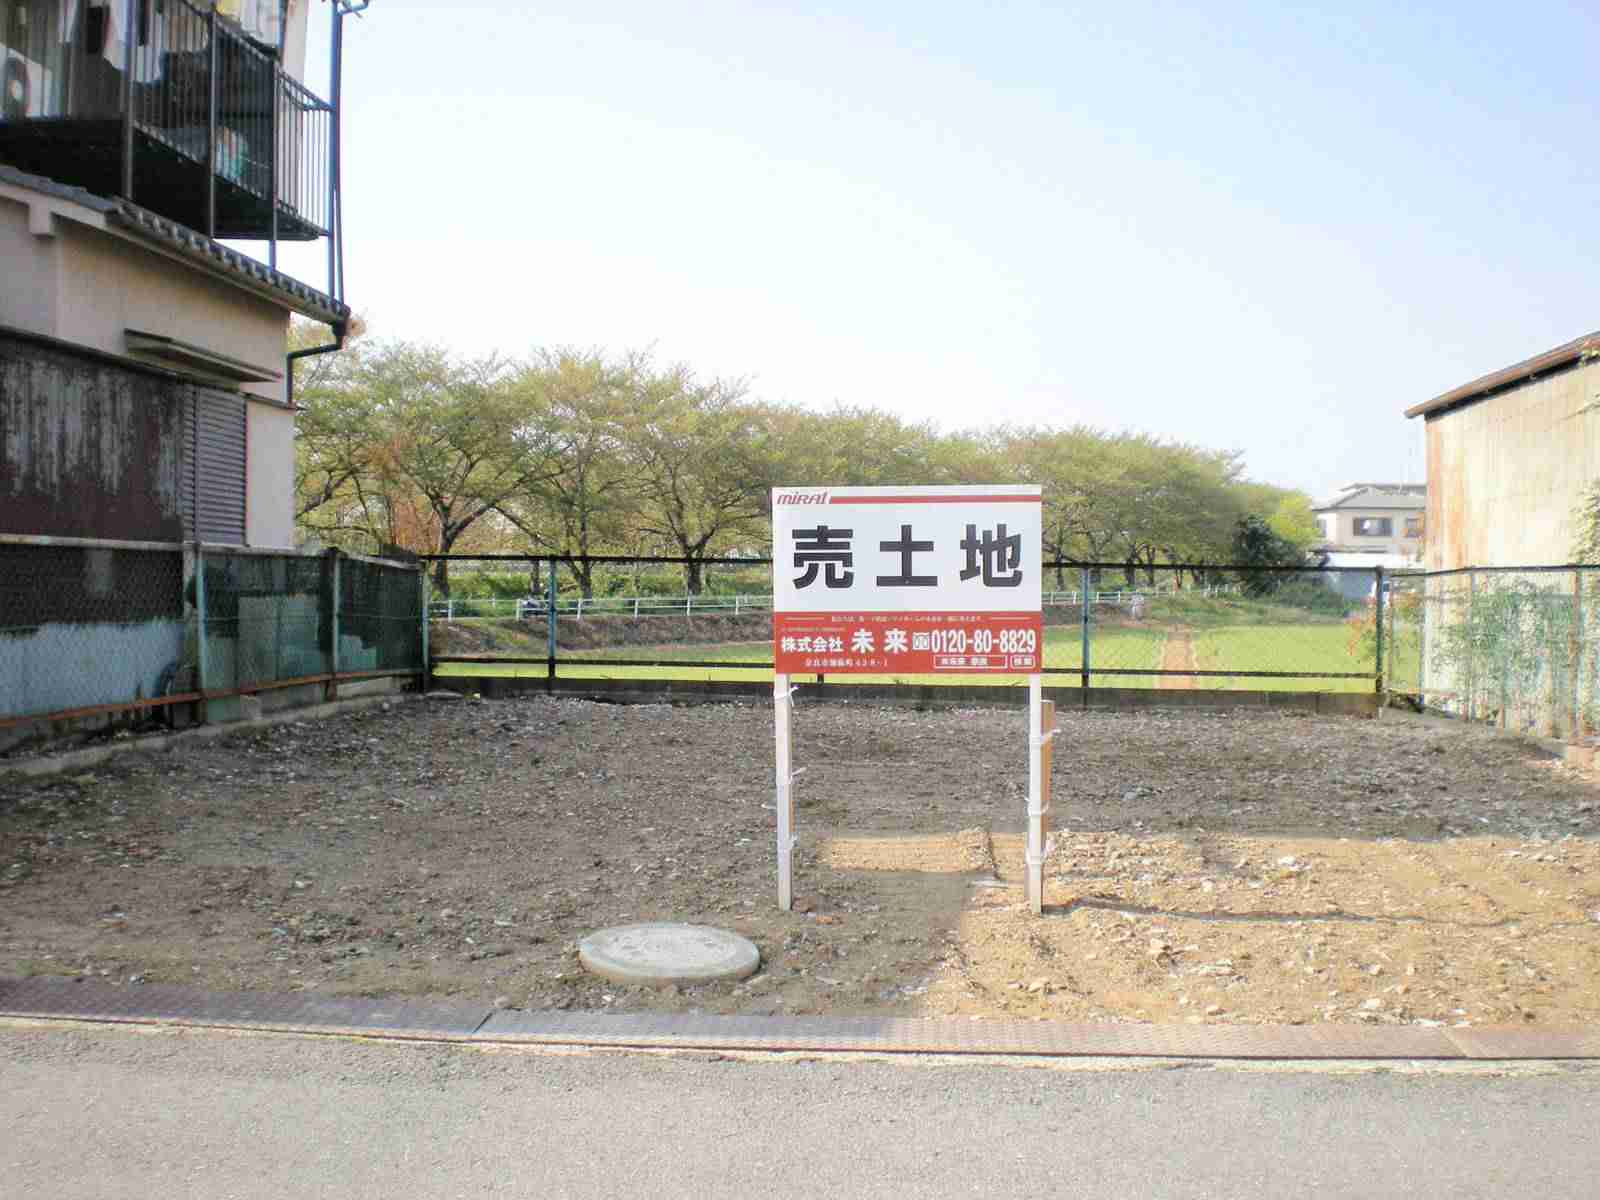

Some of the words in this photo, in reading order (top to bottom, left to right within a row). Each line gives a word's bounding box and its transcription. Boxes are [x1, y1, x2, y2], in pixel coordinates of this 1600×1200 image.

[791, 523, 1023, 589] 売土地
[781, 635, 844, 653] 株式会社
[851, 628, 908, 654] 未来
[931, 629, 1036, 653] 0120-80-8829
